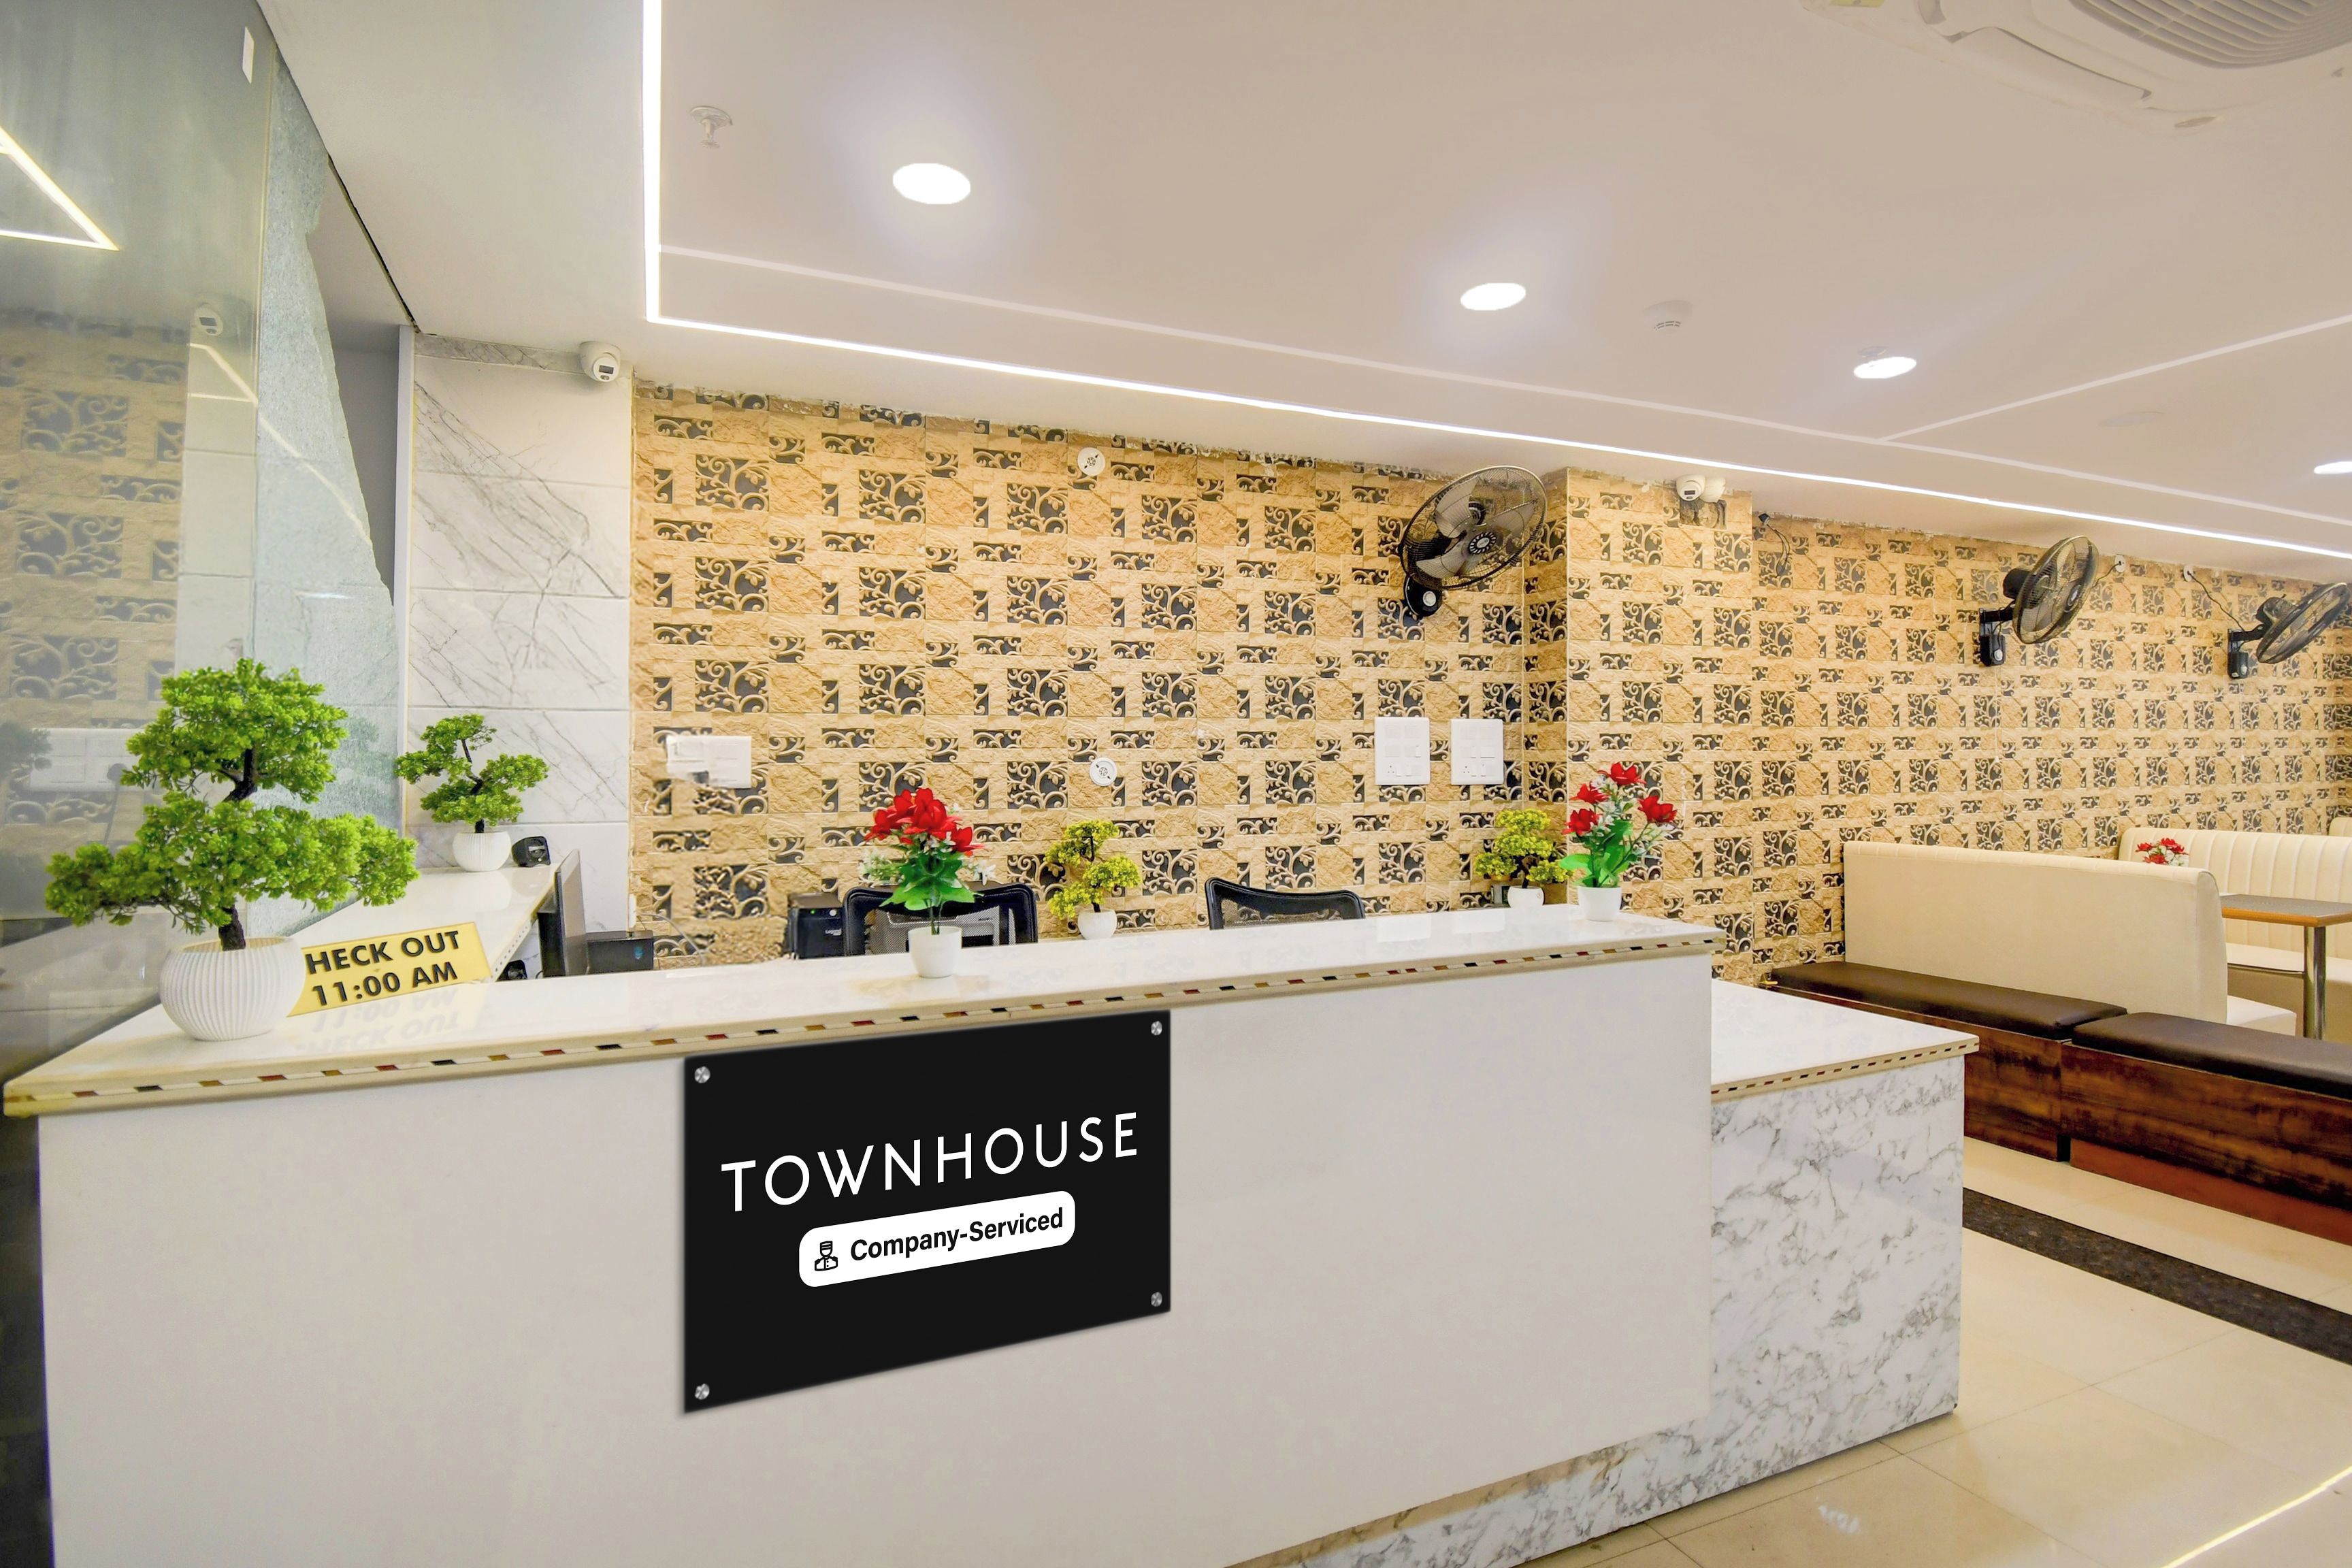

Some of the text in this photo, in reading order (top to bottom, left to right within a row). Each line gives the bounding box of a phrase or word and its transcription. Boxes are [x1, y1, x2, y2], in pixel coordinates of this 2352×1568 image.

[305, 930, 459, 975] HECK OUT
[312, 961, 458, 1007] 11:00 AM
[721, 1111, 1137, 1212] TOWNHOUSE
[851, 1207, 1063, 1261] Company-Serviced
